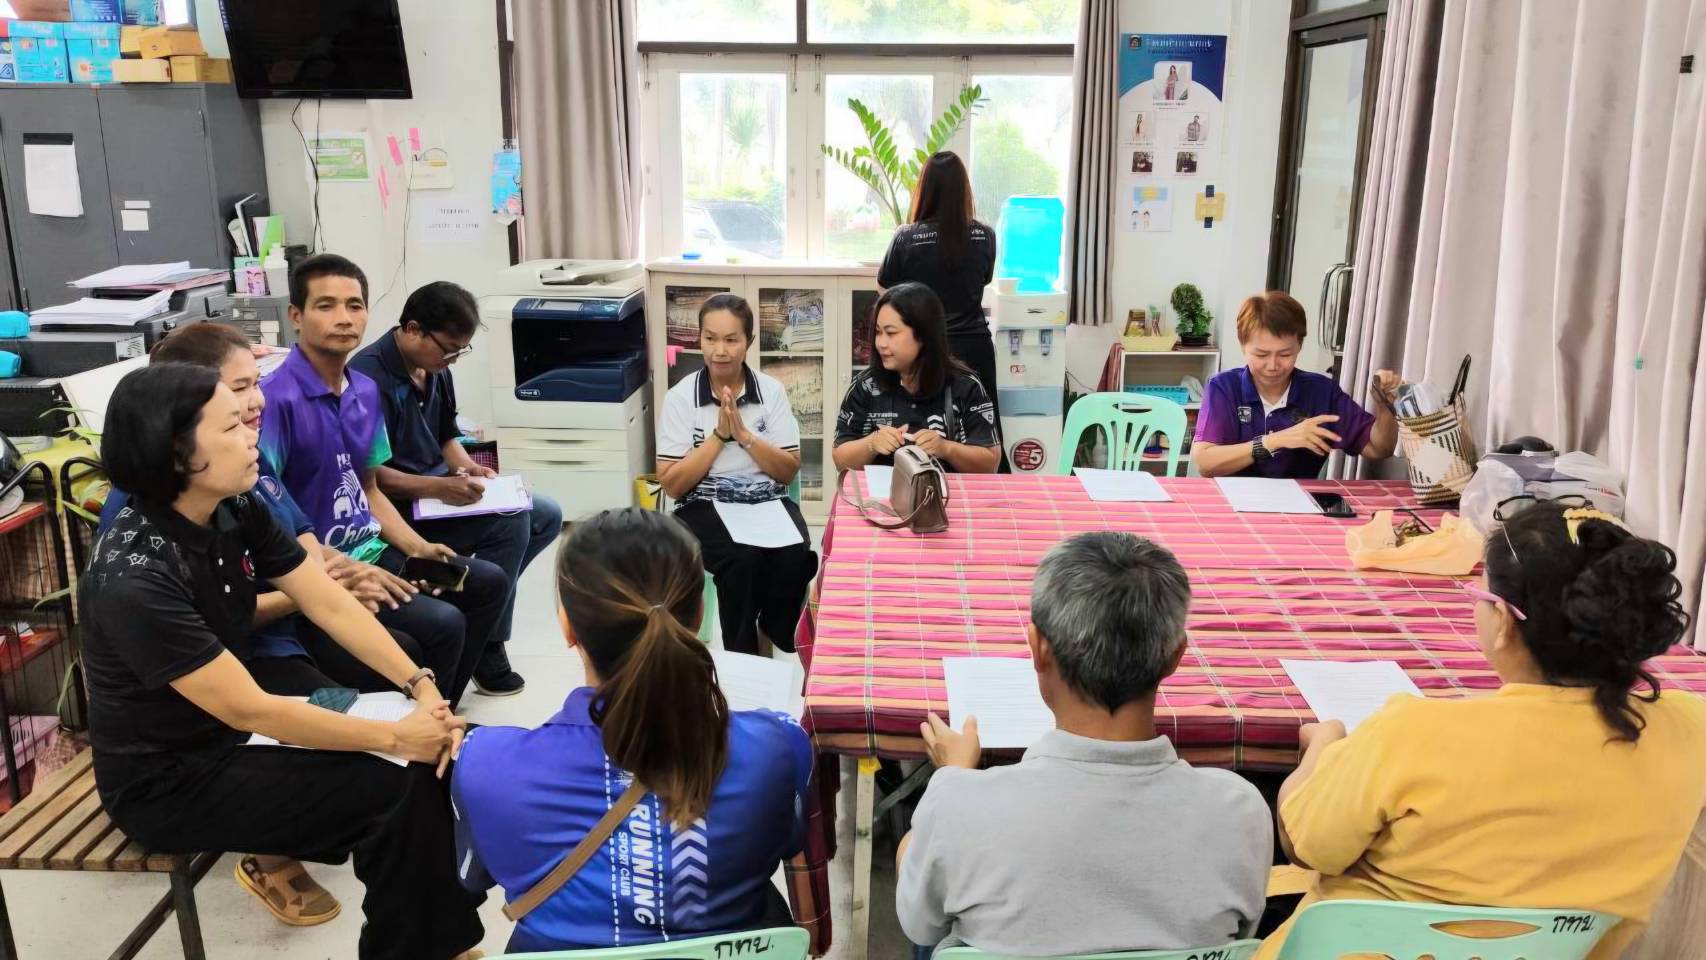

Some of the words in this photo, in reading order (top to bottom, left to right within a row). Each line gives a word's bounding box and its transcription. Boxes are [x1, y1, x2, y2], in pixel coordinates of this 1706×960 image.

[618, 831, 629, 866] SPORT
[628, 803, 656, 925] RUNNING
[620, 867, 631, 896] CLUB
